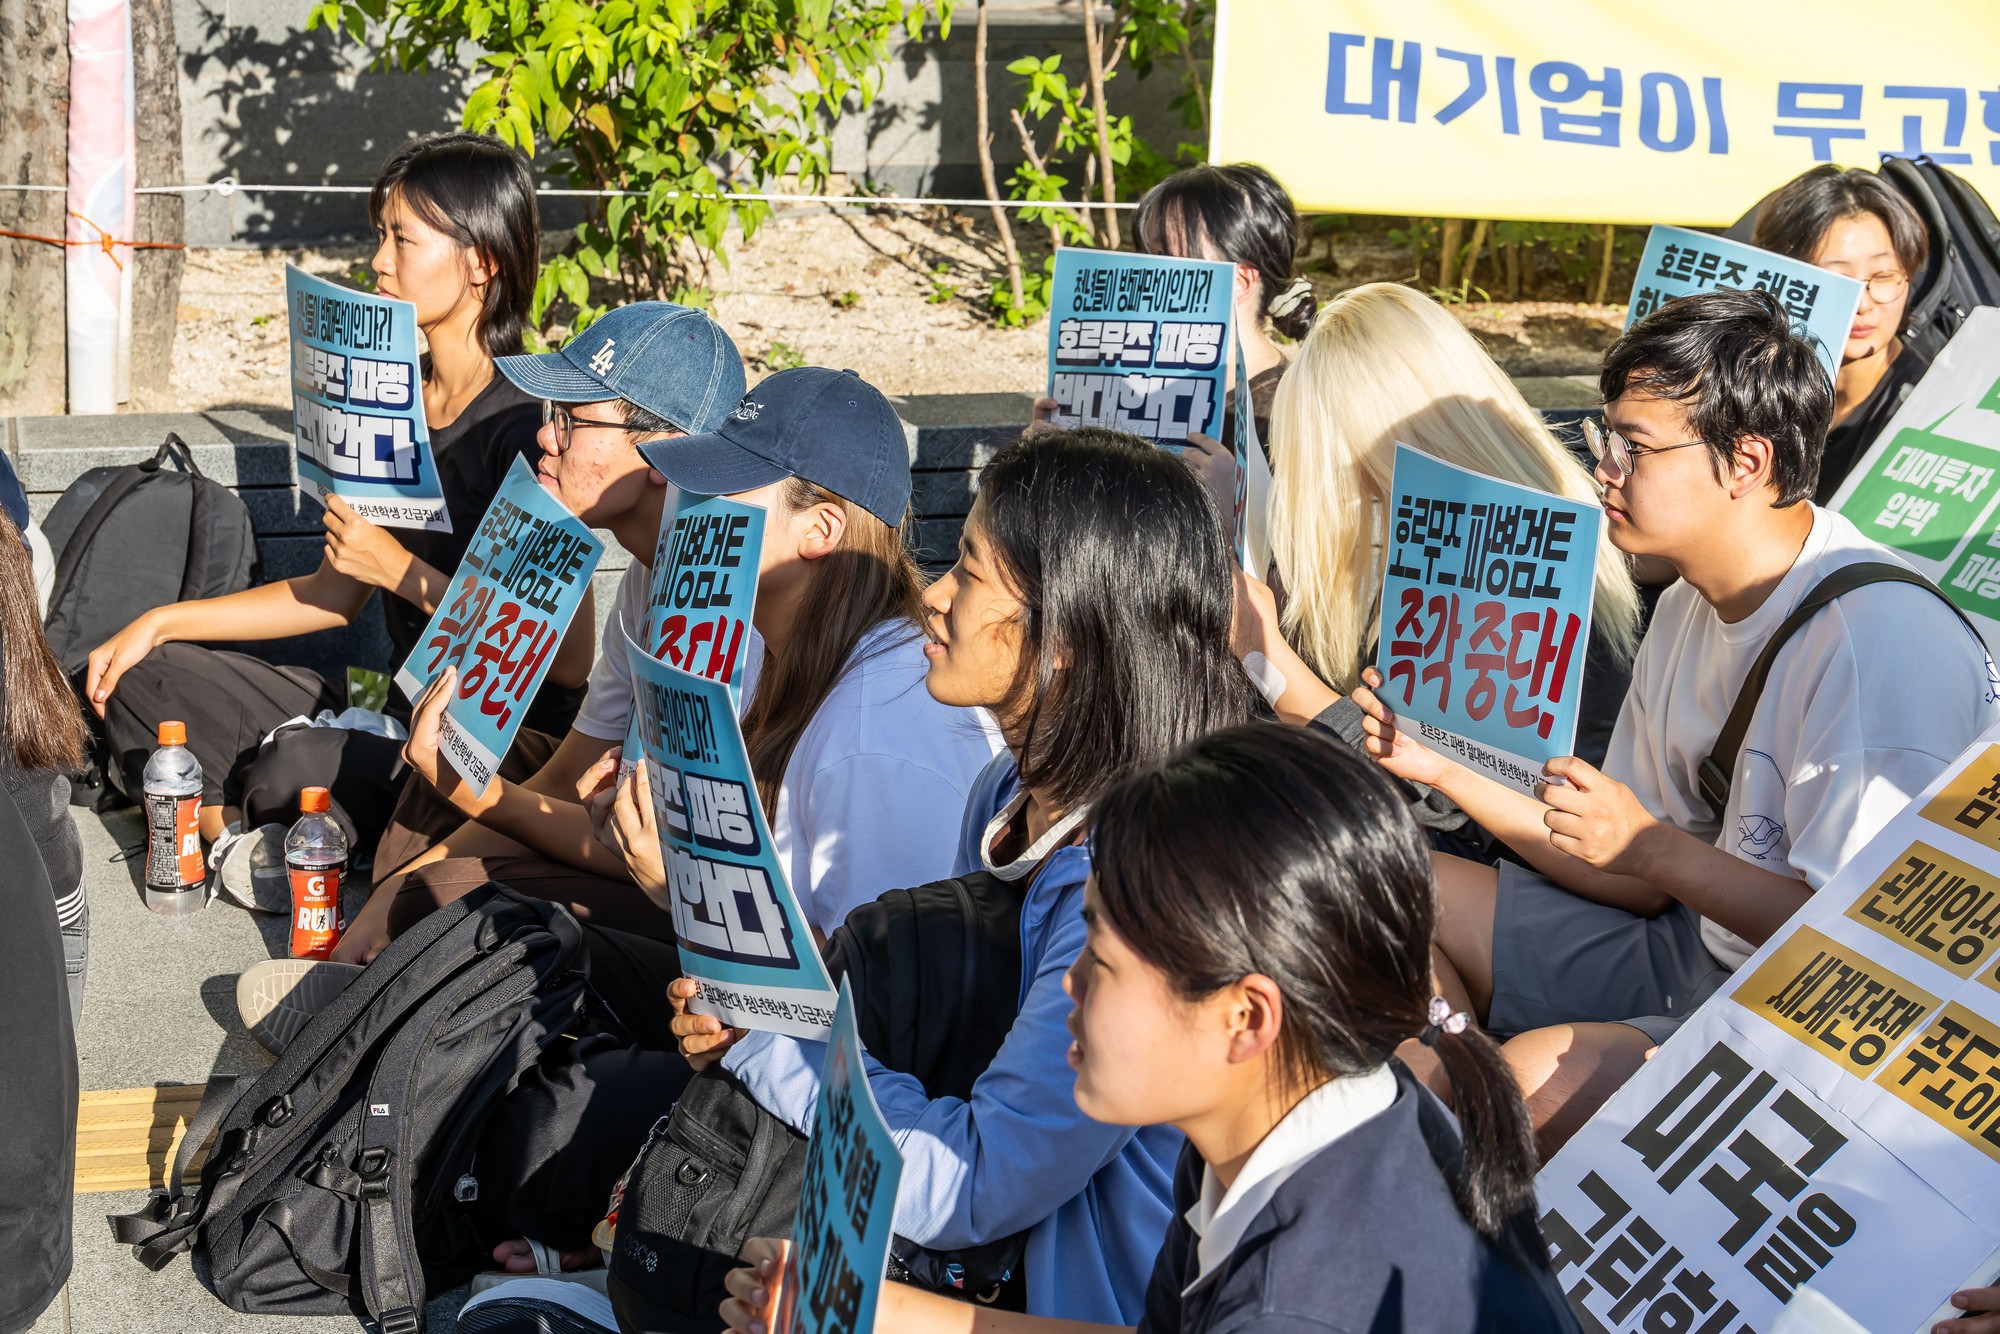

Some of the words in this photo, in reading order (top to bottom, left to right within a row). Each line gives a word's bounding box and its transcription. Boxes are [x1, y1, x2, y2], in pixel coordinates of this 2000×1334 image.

[1325, 31, 1729, 155] 대기업이
[1773, 81, 2000, 167] 무고
[1073, 268, 1118, 312] 청년들이
[1117, 268, 1213, 313] 방패막이인가?!
[1656, 243, 1747, 290] 호르무즈
[1753, 270, 1820, 321] 해협
[588, 338, 616, 377] LA
[1056, 319, 1155, 362] 호르무즈
[1155, 322, 1223, 365] 파병
[349, 358, 410, 405] 파병
[1050, 373, 1213, 439] 반대한다
[295, 394, 416, 479] 반대한다
[1881, 445, 1996, 503] 대미투자
[358, 504, 400, 520] 청년학생
[401, 506, 445, 523] 긴급집회
[458, 601, 558, 731] 중단!
[1389, 588, 1463, 714] 즉각
[1465, 601, 1581, 740] 중단!
[1419, 721, 1449, 747] 호르무즈
[1449, 735, 1465, 756] 파병
[1466, 742, 1498, 772] 절대반대
[1498, 758, 1530, 787] 청년학생
[684, 774, 755, 845] 파병
[307, 876, 325, 896] G
[661, 845, 791, 959] 대한다
[297, 906, 337, 933] RUN
[703, 983, 746, 1012] 절대반대
[744, 995, 793, 1020] 청년학생
[1765, 950, 1927, 1067] 세계전쟁
[1621, 1040, 1857, 1306] 미국을
[1537, 1169, 1757, 1334] 규탄한
